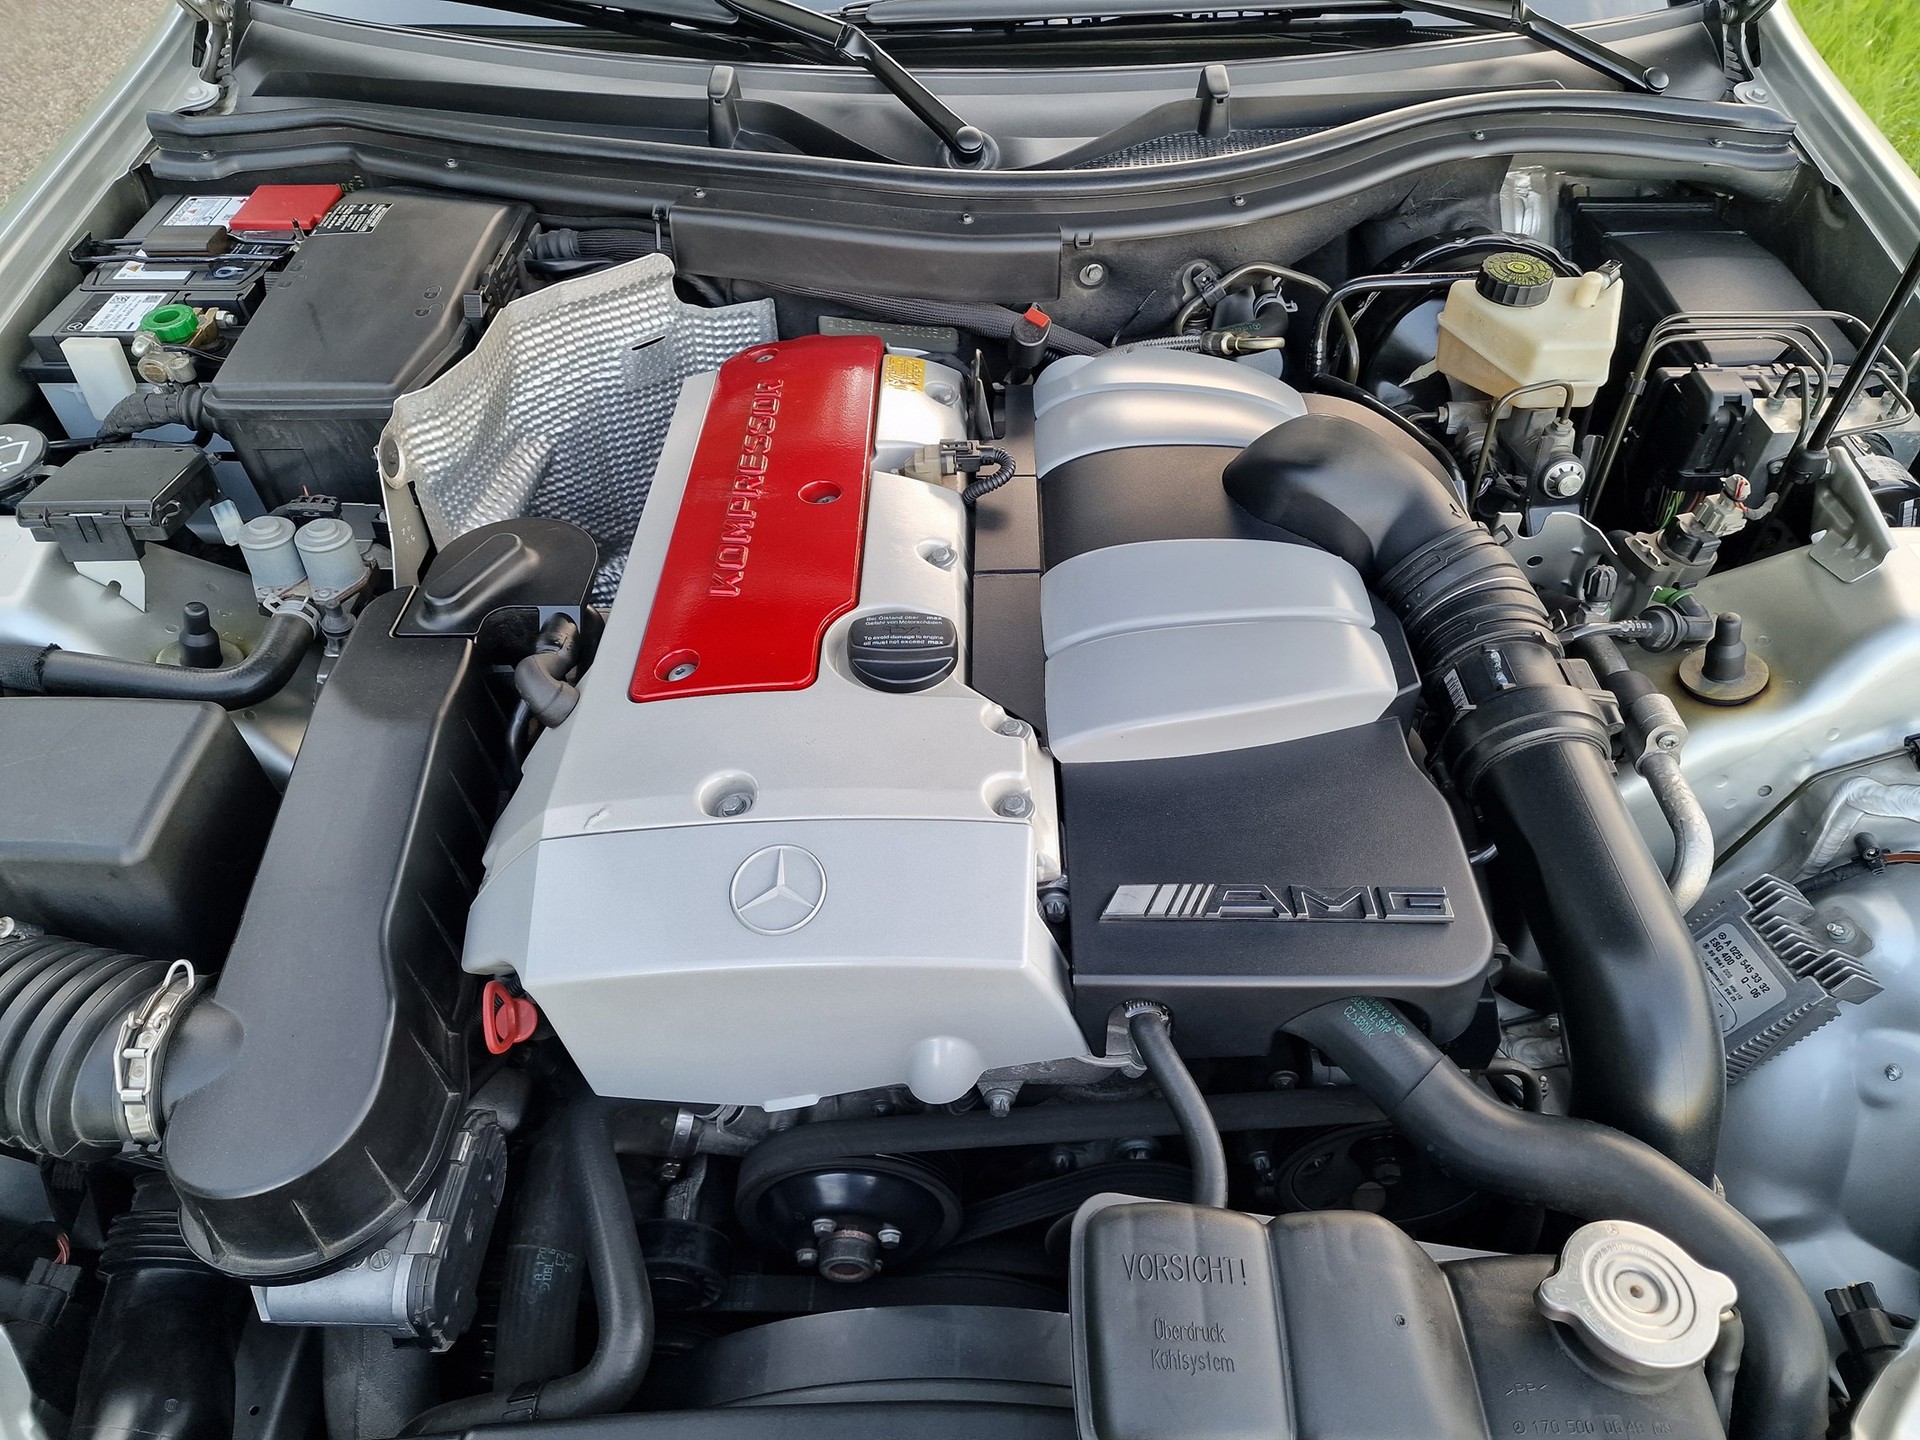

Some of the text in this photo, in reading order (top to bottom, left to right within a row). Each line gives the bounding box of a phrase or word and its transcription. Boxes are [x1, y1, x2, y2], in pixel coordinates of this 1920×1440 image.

[708, 379, 784, 598] KOMPRESSOR
[1203, 884, 1455, 923] AMG
[1709, 937, 1724, 952] ESG
[1721, 952, 1735, 966] 400
[1729, 946, 1744, 960] 025
[1740, 959, 1755, 974] 545
[1751, 972, 1763, 984] 33
[1759, 982, 1771, 994] 32
[1122, 1253, 1247, 1286] VORSICHT!
[1153, 1316, 1227, 1344] Überdruck
[1532, 1419, 1561, 1436] 170
[1565, 1419, 1595, 1436] 500
